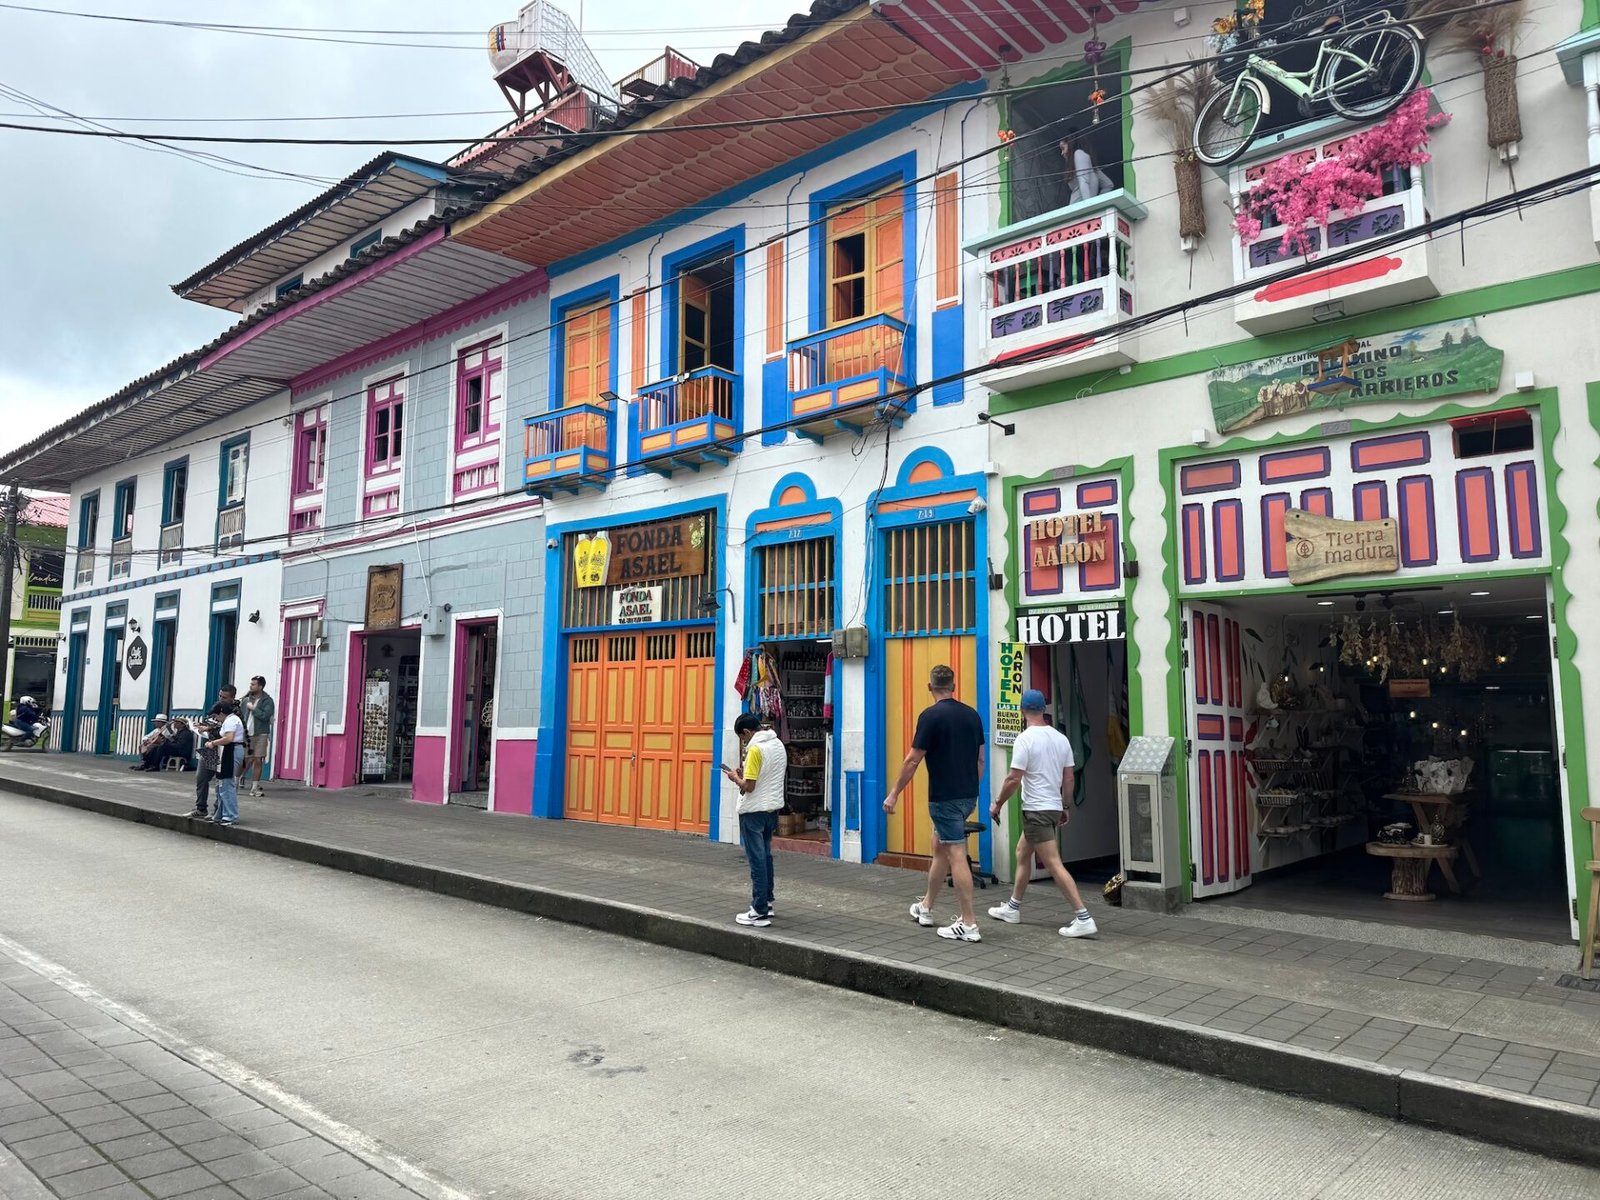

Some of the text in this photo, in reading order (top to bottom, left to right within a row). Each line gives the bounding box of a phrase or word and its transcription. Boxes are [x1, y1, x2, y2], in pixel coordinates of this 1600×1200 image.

[1350, 370, 1458, 398] ARRIEROS
[1354, 366, 1387, 381] LOS
[1029, 511, 1106, 541] HOTEL
[1325, 529, 1384, 546] Tierra
[616, 526, 682, 554] FONDA
[1325, 540, 1395, 563] madura
[620, 552, 682, 579] ASAEL
[1033, 540, 1106, 568] AARON
[619, 589, 653, 603] FONDA
[619, 603, 652, 617] ASAEL
[1017, 610, 1126, 645] HOTEL
[1000, 643, 1013, 704] HOTEL
[1013, 651, 1023, 695] ARON
[996, 717, 1021, 725] BONITO
[997, 723, 1020, 732] BARATO
